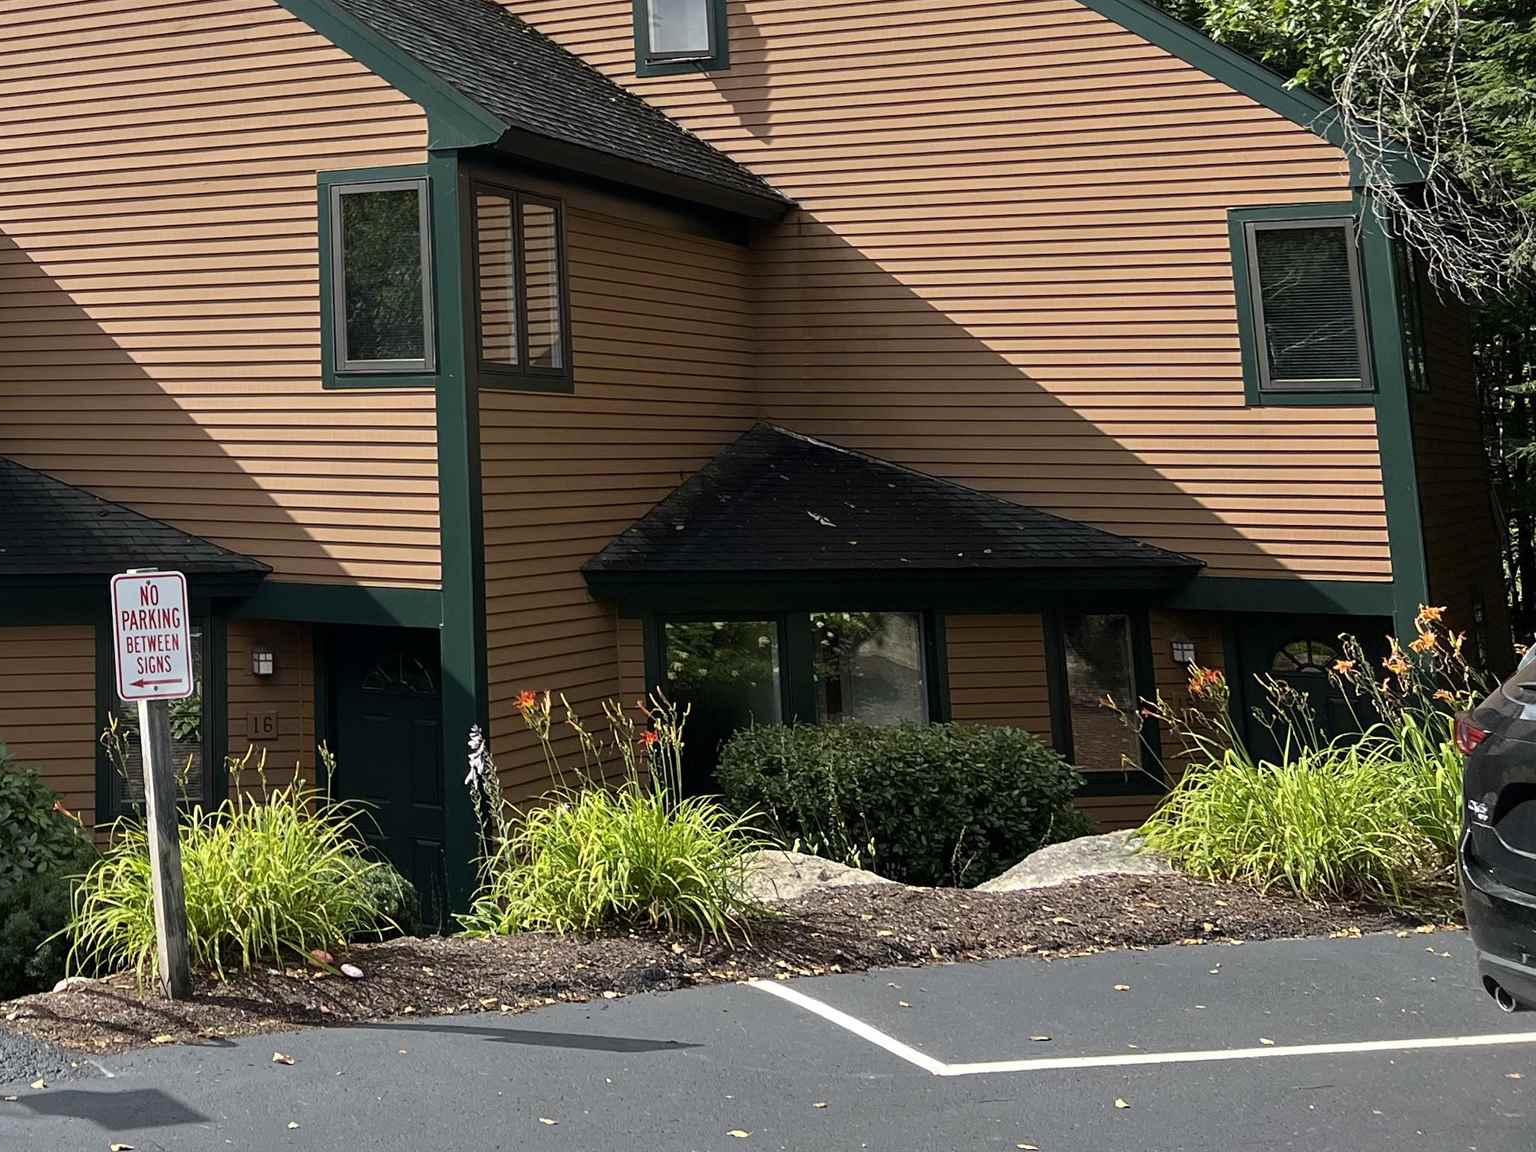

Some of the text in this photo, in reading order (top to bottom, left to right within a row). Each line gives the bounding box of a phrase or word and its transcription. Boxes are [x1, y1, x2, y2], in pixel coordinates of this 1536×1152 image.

[140, 585, 159, 606] NO
[122, 608, 181, 631] PARKING
[126, 634, 180, 654] BETWEEN
[136, 655, 172, 675] SIGNS
[253, 716, 273, 734] 16
